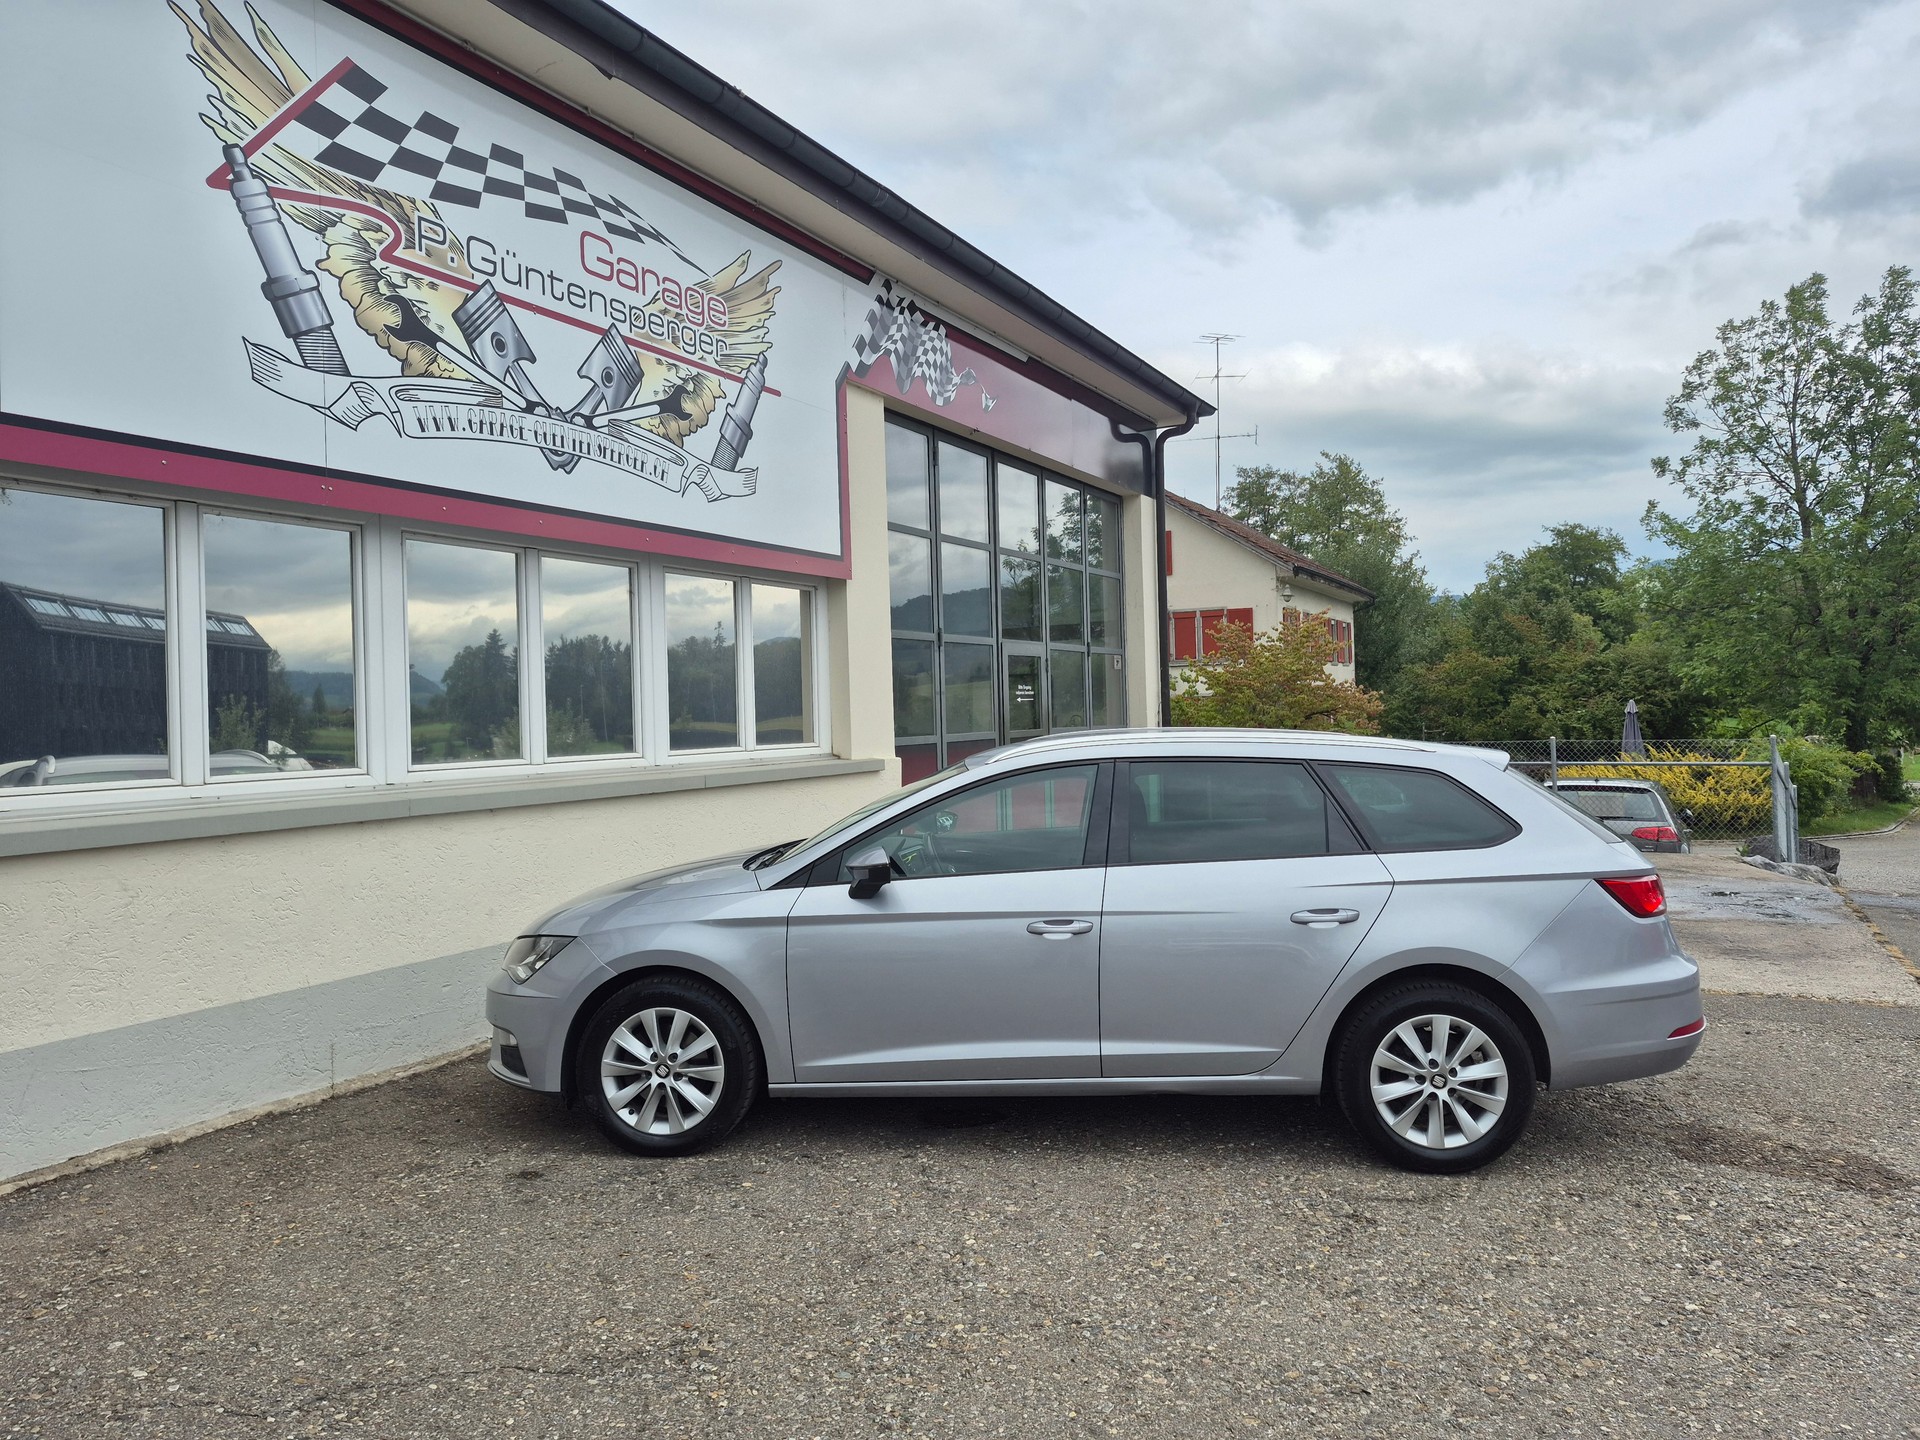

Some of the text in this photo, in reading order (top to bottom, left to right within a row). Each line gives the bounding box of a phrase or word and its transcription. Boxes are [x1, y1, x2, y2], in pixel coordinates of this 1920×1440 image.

[417, 215, 728, 358] P. Güntensperger
[580, 230, 728, 328] Garage
[412, 405, 671, 484] WWW.GARAGE-GUENTENSPERGER.CH
